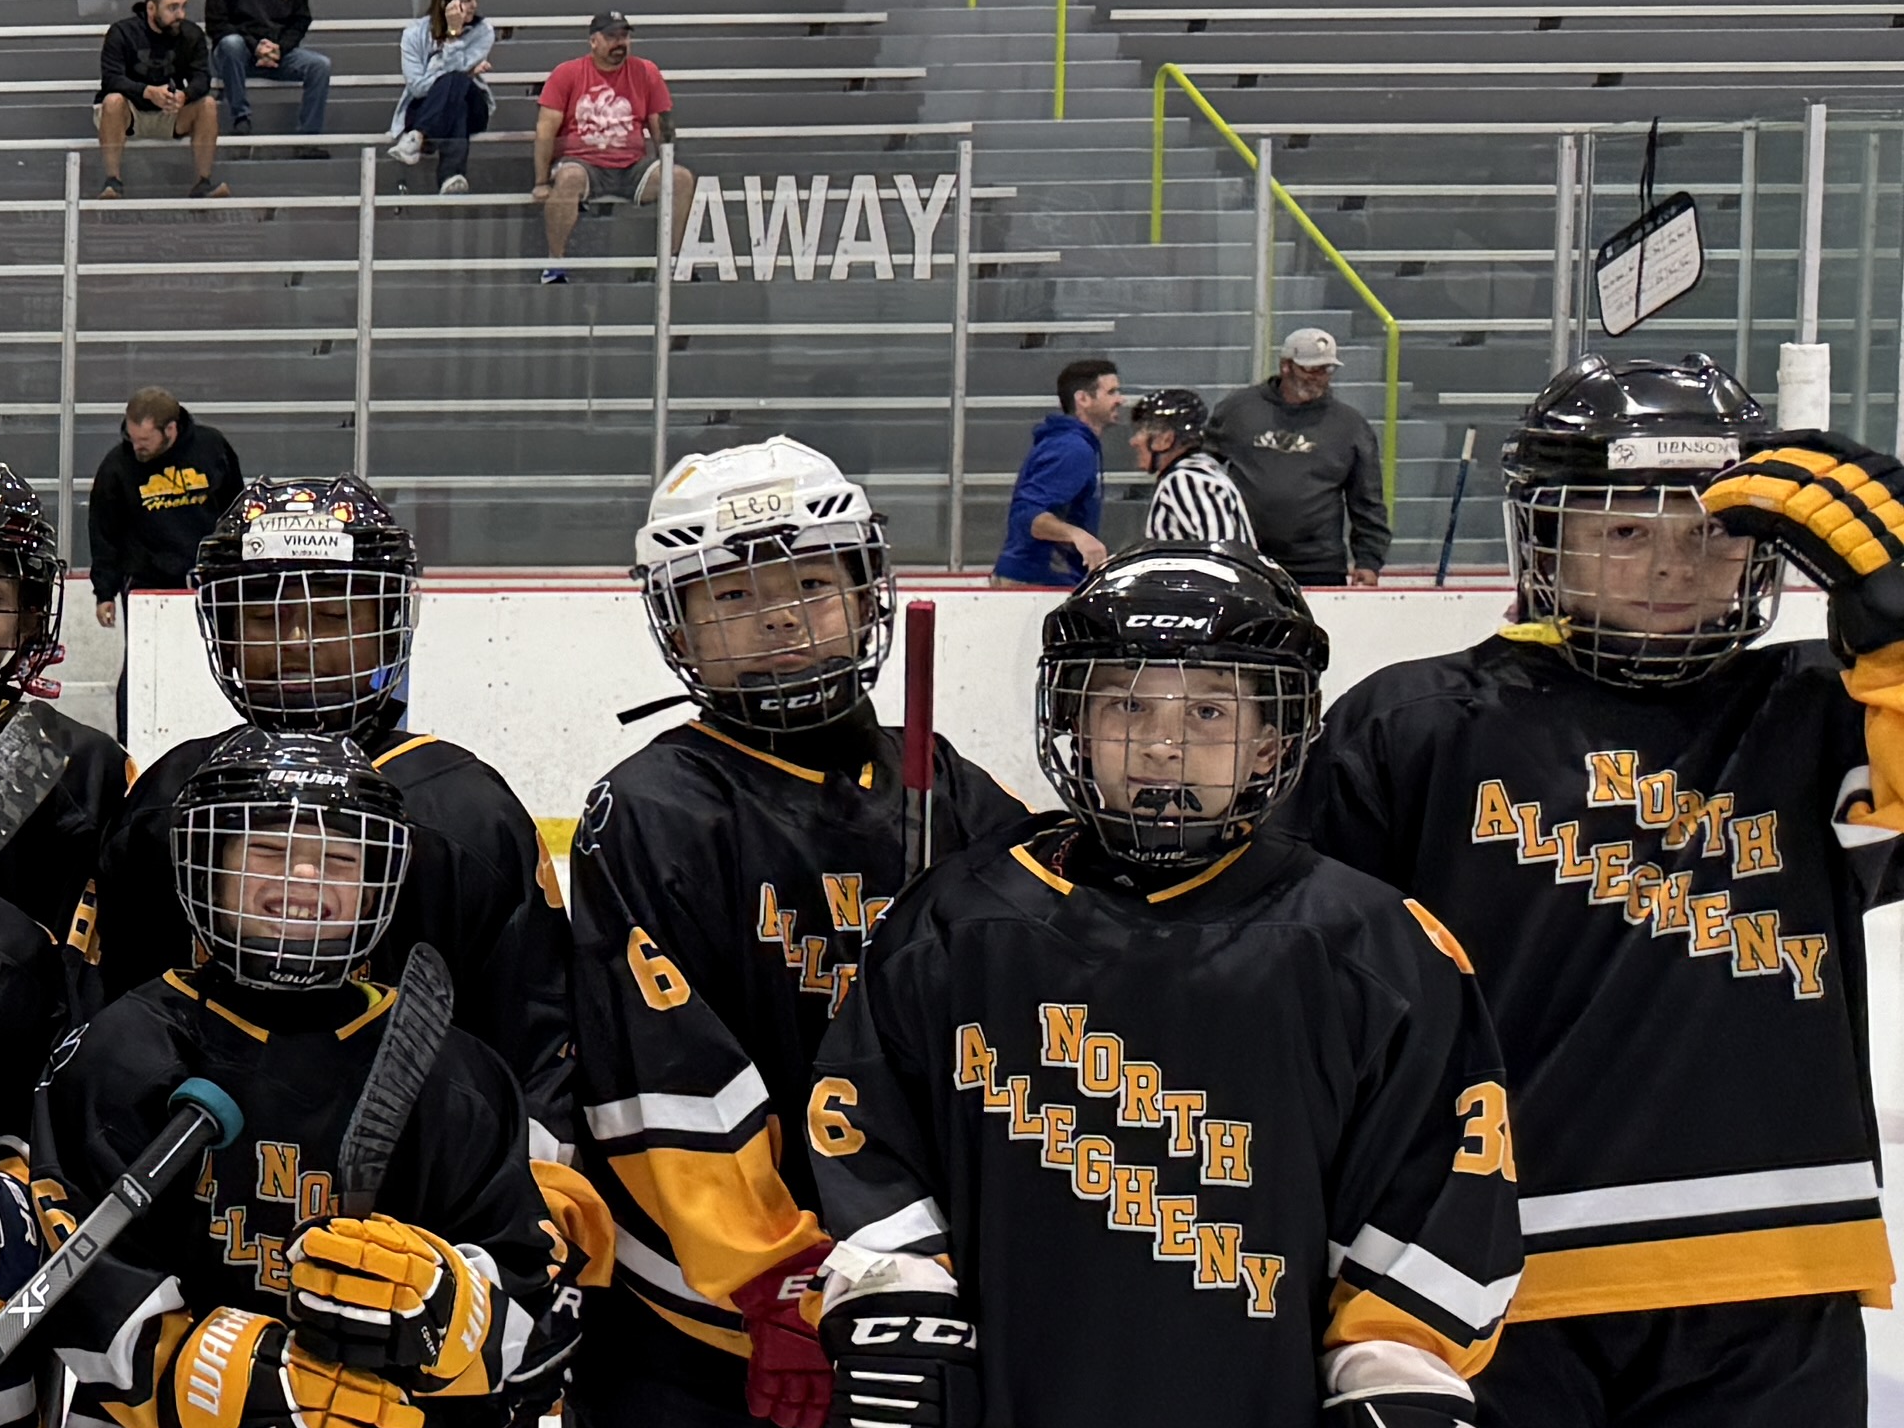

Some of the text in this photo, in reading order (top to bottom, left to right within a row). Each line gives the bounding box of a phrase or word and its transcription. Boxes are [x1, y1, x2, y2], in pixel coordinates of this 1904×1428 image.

[673, 174, 957, 282] AWAY
[1125, 614, 1209, 631] CCM
[1586, 750, 1783, 878] NORTH
[1471, 778, 1827, 1000] ALLEGHENY
[626, 926, 692, 1012] 6
[805, 1076, 868, 1158] 6
[1040, 1002, 1253, 1187] NORTH
[955, 1021, 1286, 1319] ALLEGHENY
